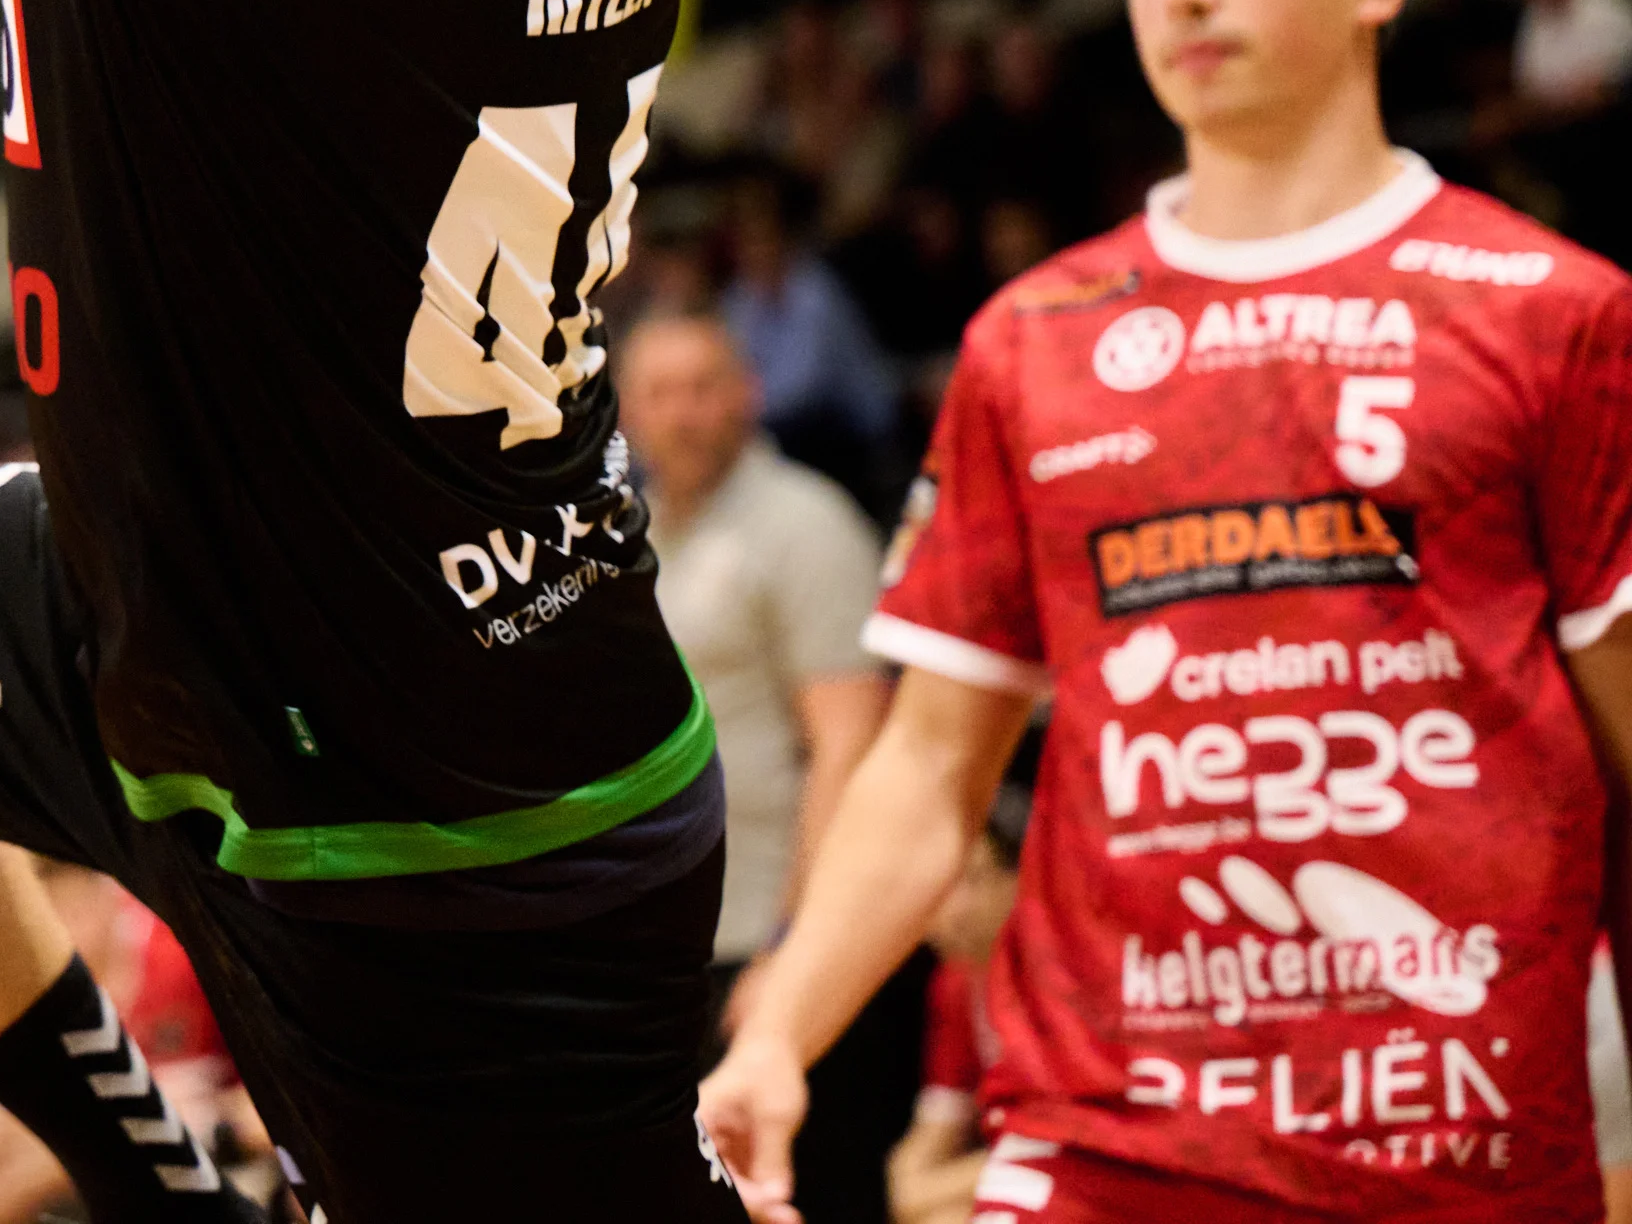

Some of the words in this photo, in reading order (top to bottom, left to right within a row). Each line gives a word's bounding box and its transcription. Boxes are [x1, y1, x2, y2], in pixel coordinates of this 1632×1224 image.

[1190, 293, 1418, 352] ALTREA
[1334, 376, 1416, 487] 5
[1171, 635, 1350, 702] crelan
